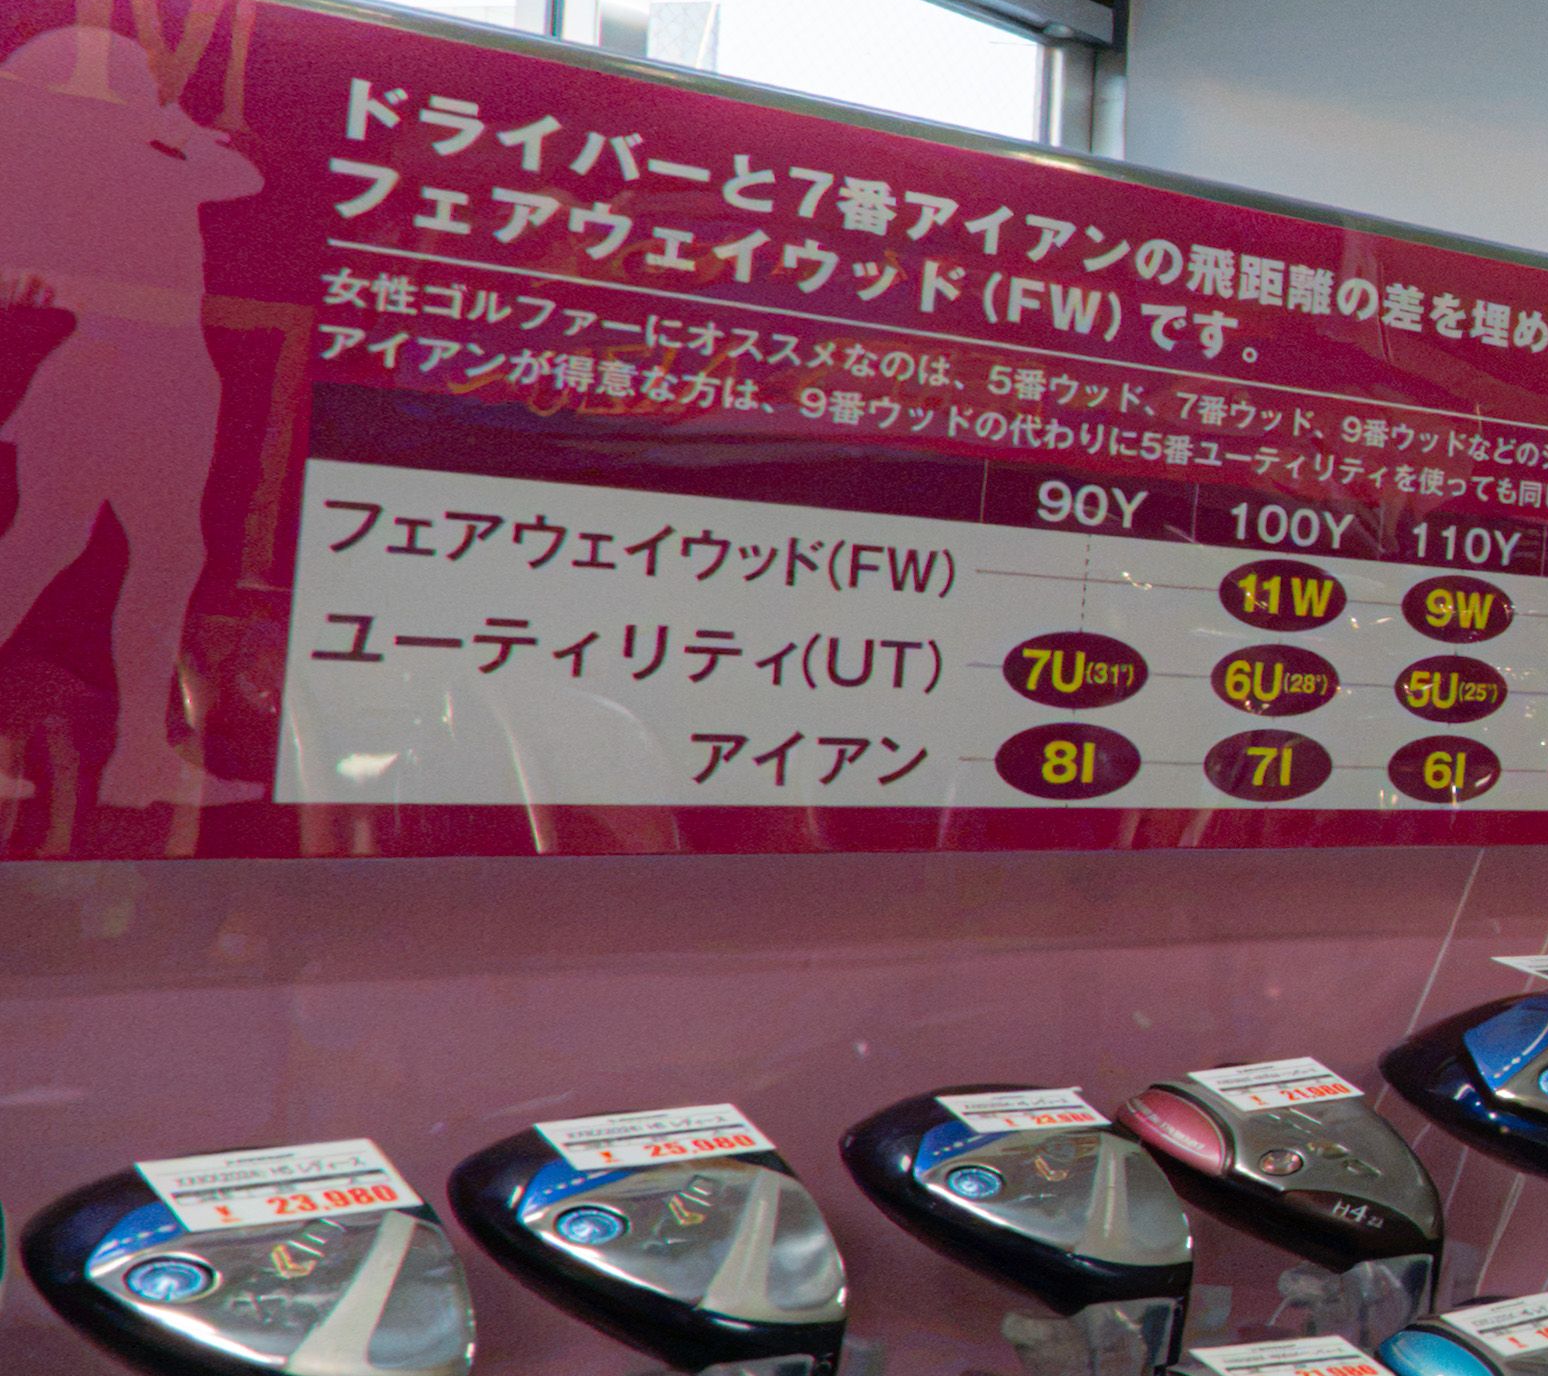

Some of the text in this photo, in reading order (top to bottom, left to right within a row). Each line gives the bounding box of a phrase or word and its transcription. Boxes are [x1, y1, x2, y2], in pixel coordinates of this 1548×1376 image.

[1038, 480, 1149, 529] 90Y
[1230, 502, 1354, 551] 100Y
[1411, 522, 1521, 568] 110Y
[322, 495, 957, 599] フェアウェイウッド(FW)
[1237, 573, 1333, 619] 11W
[1424, 588, 1494, 631] 9W
[312, 611, 943, 694] ユーティリティ(UT)
[690, 728, 929, 787] アイアン
[1041, 740, 1096, 785] 8I
[1246, 745, 1293, 789] 7I
[1423, 751, 1467, 791] 6I
[647, 1132, 757, 1159] 25,980
[268, 1182, 399, 1216] 23,980
